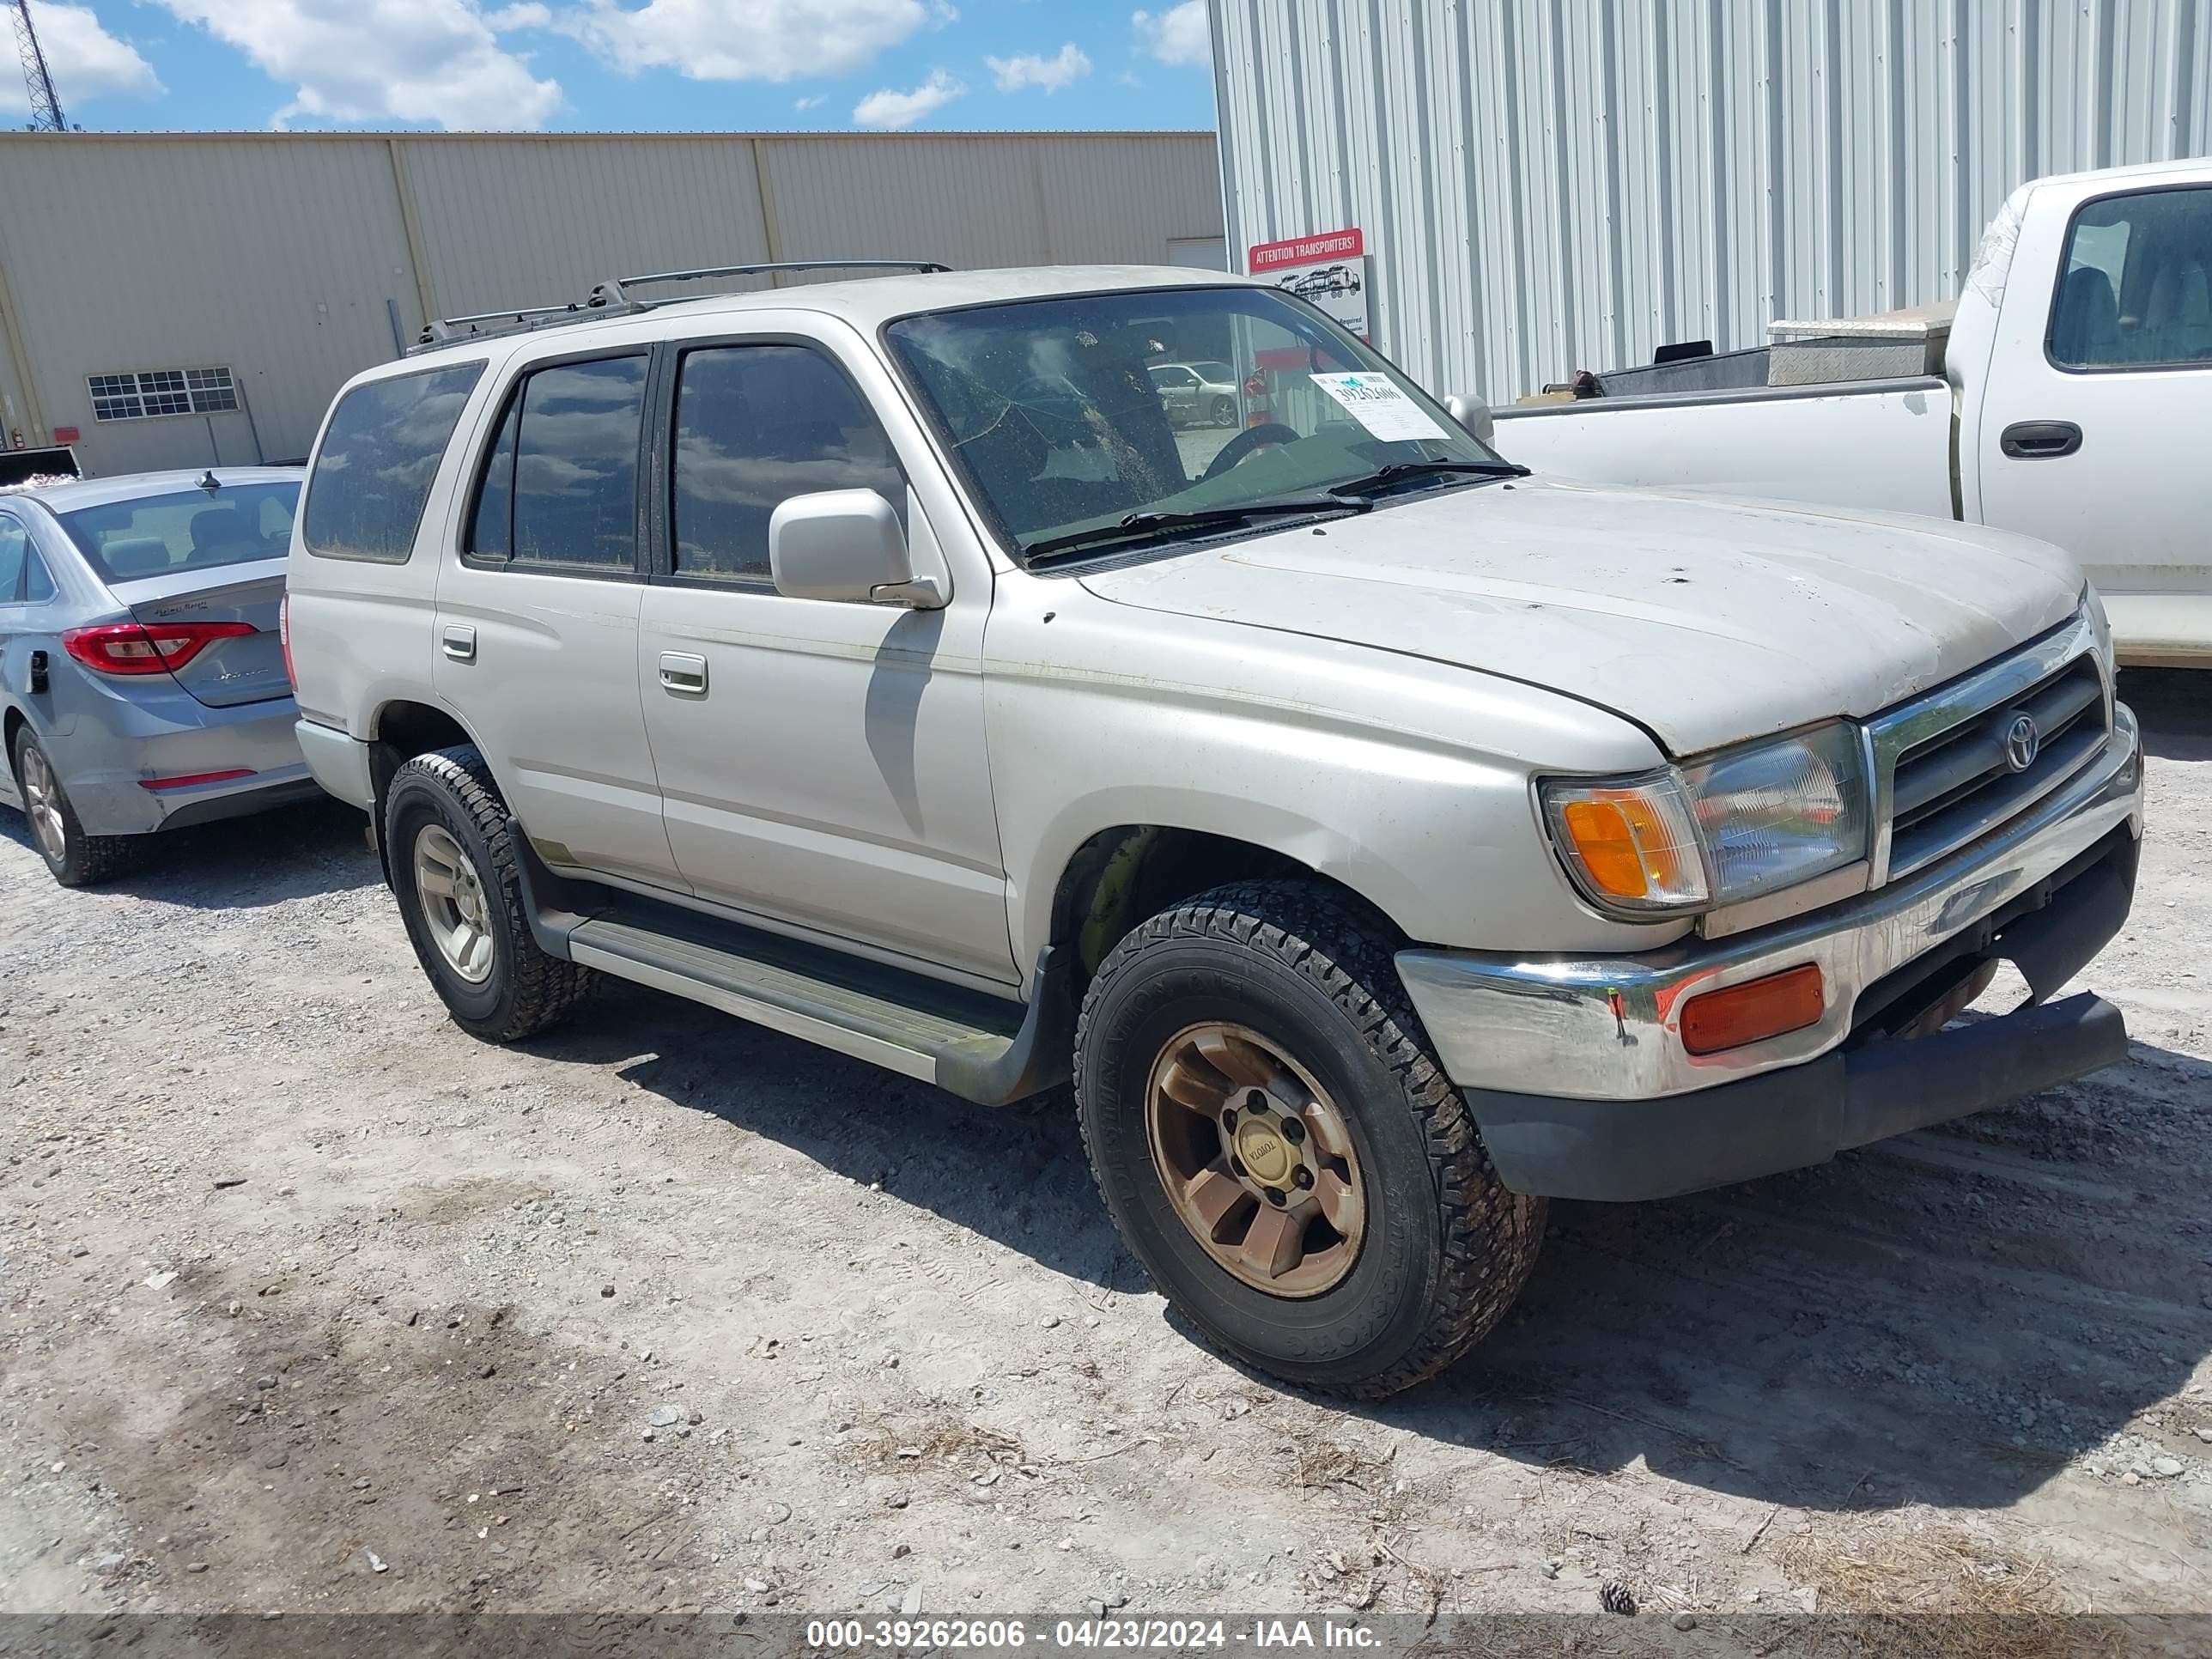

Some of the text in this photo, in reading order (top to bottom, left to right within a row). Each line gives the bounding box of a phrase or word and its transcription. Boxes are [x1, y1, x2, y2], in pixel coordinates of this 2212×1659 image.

[1256, 236, 1355, 264] ATTENTION TRANSPORTERS!
[1335, 386, 1401, 402] 39262606
[1249, 1140, 1277, 1162] TOYOTA
